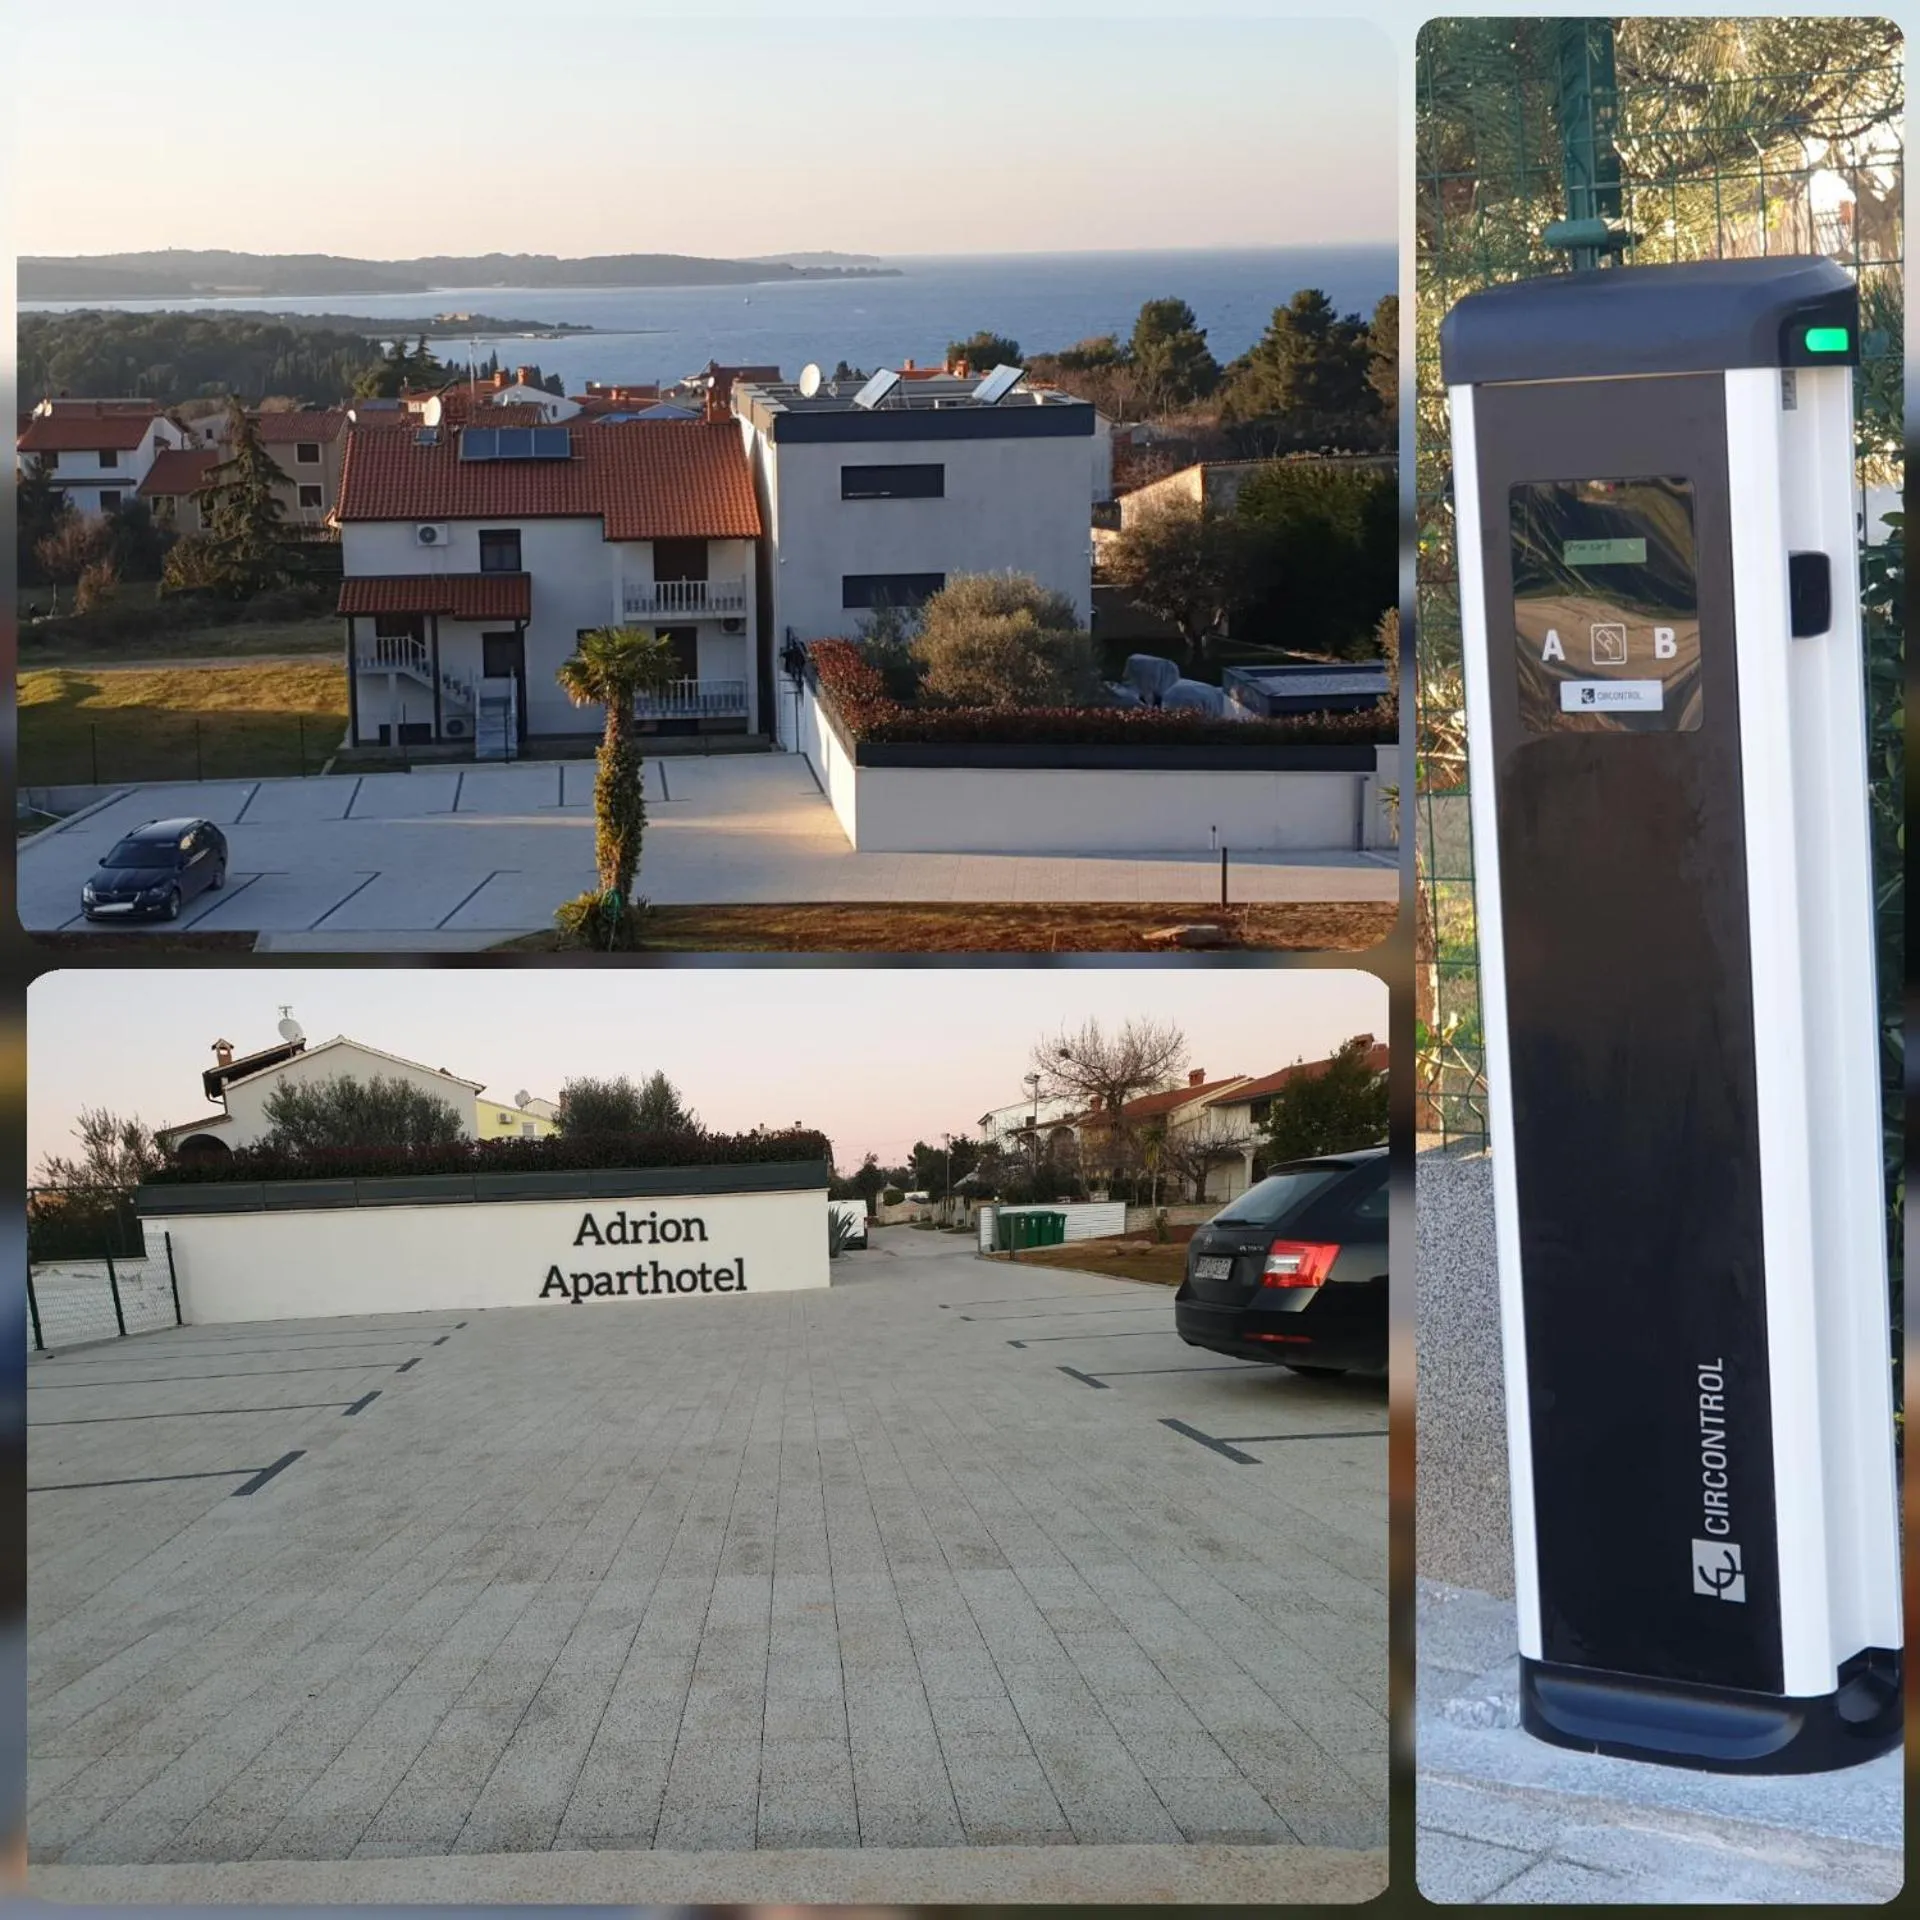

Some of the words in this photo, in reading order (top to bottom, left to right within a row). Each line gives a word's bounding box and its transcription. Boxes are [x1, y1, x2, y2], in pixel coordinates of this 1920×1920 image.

[1541, 628, 1566, 662] A
[1653, 626, 1678, 659] B
[1597, 691, 1643, 701] CIRCONTROL
[573, 1211, 708, 1246] Adrion
[539, 1258, 747, 1304] Aparthotel
[1698, 1358, 1730, 1535] CIRCONTROL
